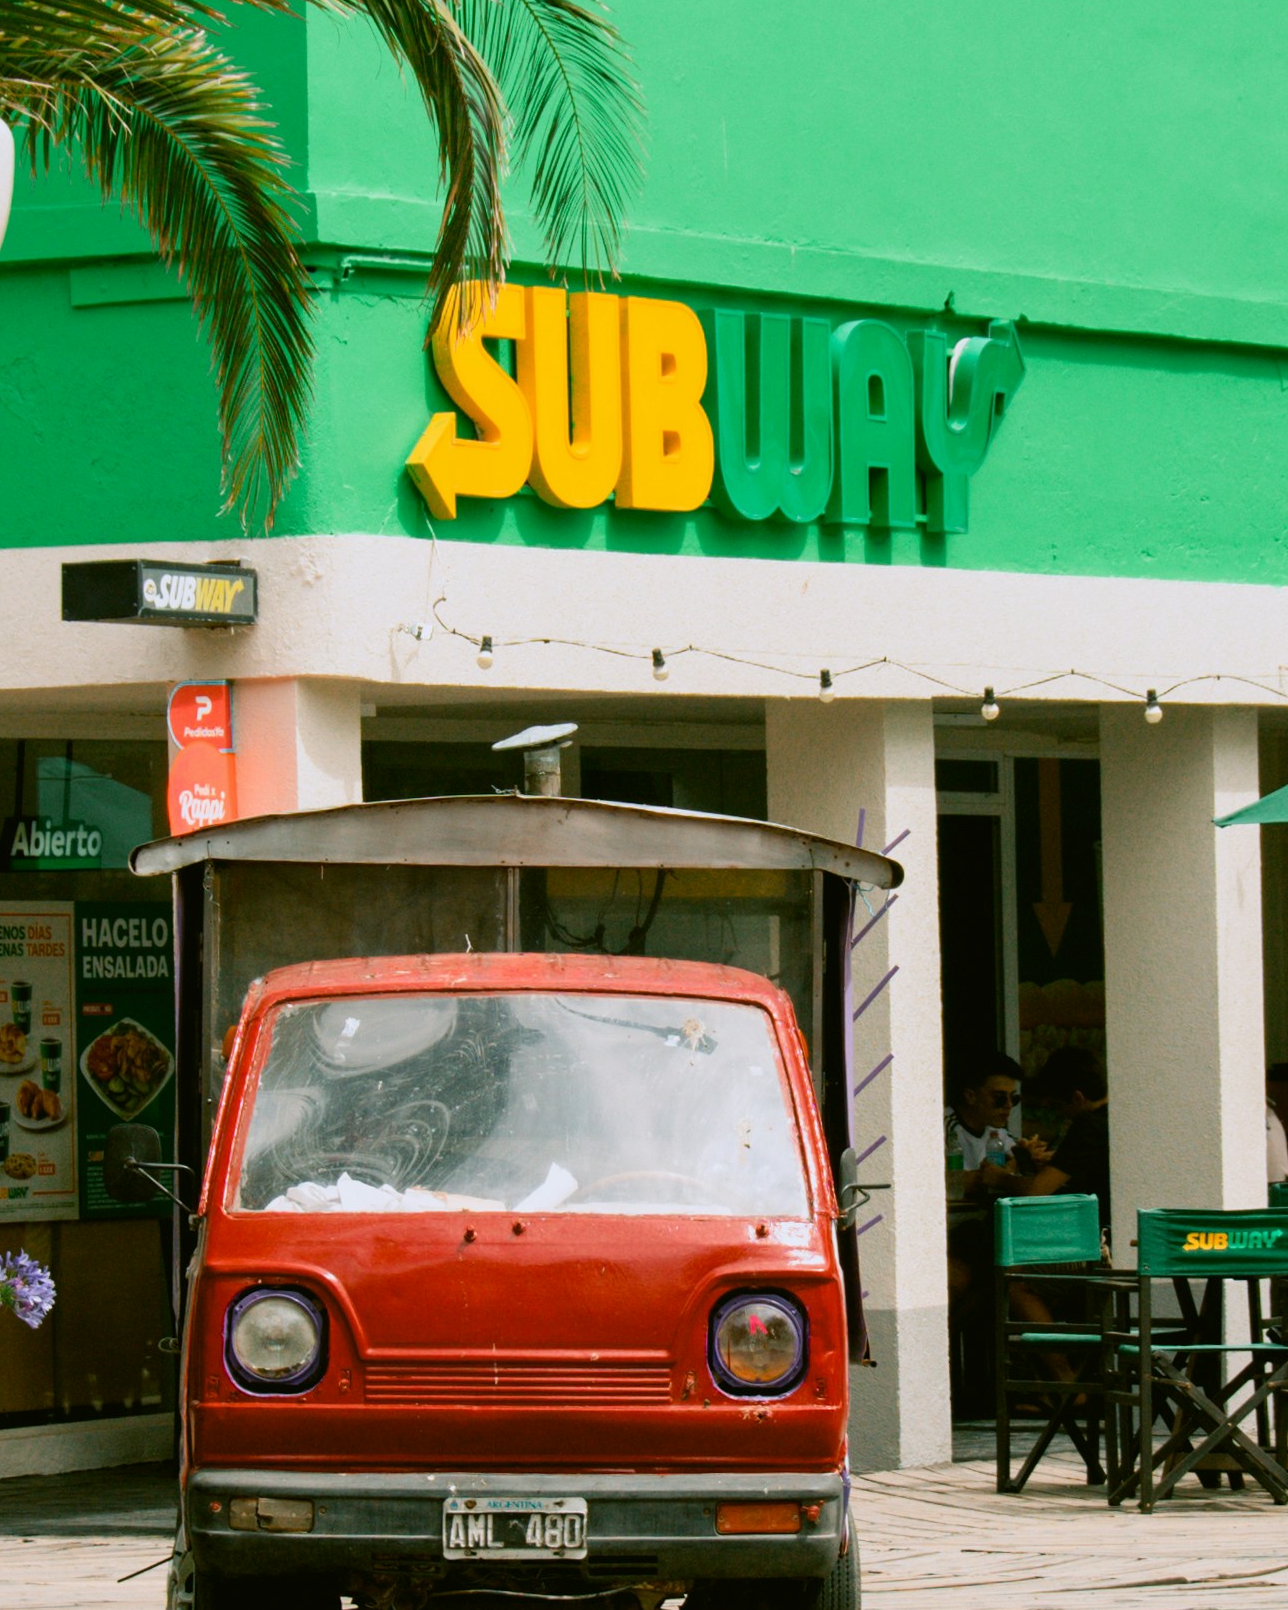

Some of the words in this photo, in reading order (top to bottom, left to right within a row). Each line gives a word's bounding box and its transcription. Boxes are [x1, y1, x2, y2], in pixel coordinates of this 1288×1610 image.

[405, 279, 1025, 535] SUBWAY
[155, 573, 245, 614] SUBWAY
[183, 725, 225, 739] PedidosYa
[194, 783, 209, 797] Pedi
[179, 791, 226, 828] Rappi
[11, 820, 102, 858] Abierto
[28, 921, 52, 939] DÍAS
[81, 917, 169, 948] HACELO
[27, 942, 65, 956] TARDES
[82, 955, 169, 979] ENSALADA
[1182, 1229, 1284, 1252] SUBWAY
[486, 1500, 544, 1510] ARGENTINA
[449, 1513, 505, 1549] AML
[525, 1513, 583, 1549] 480
